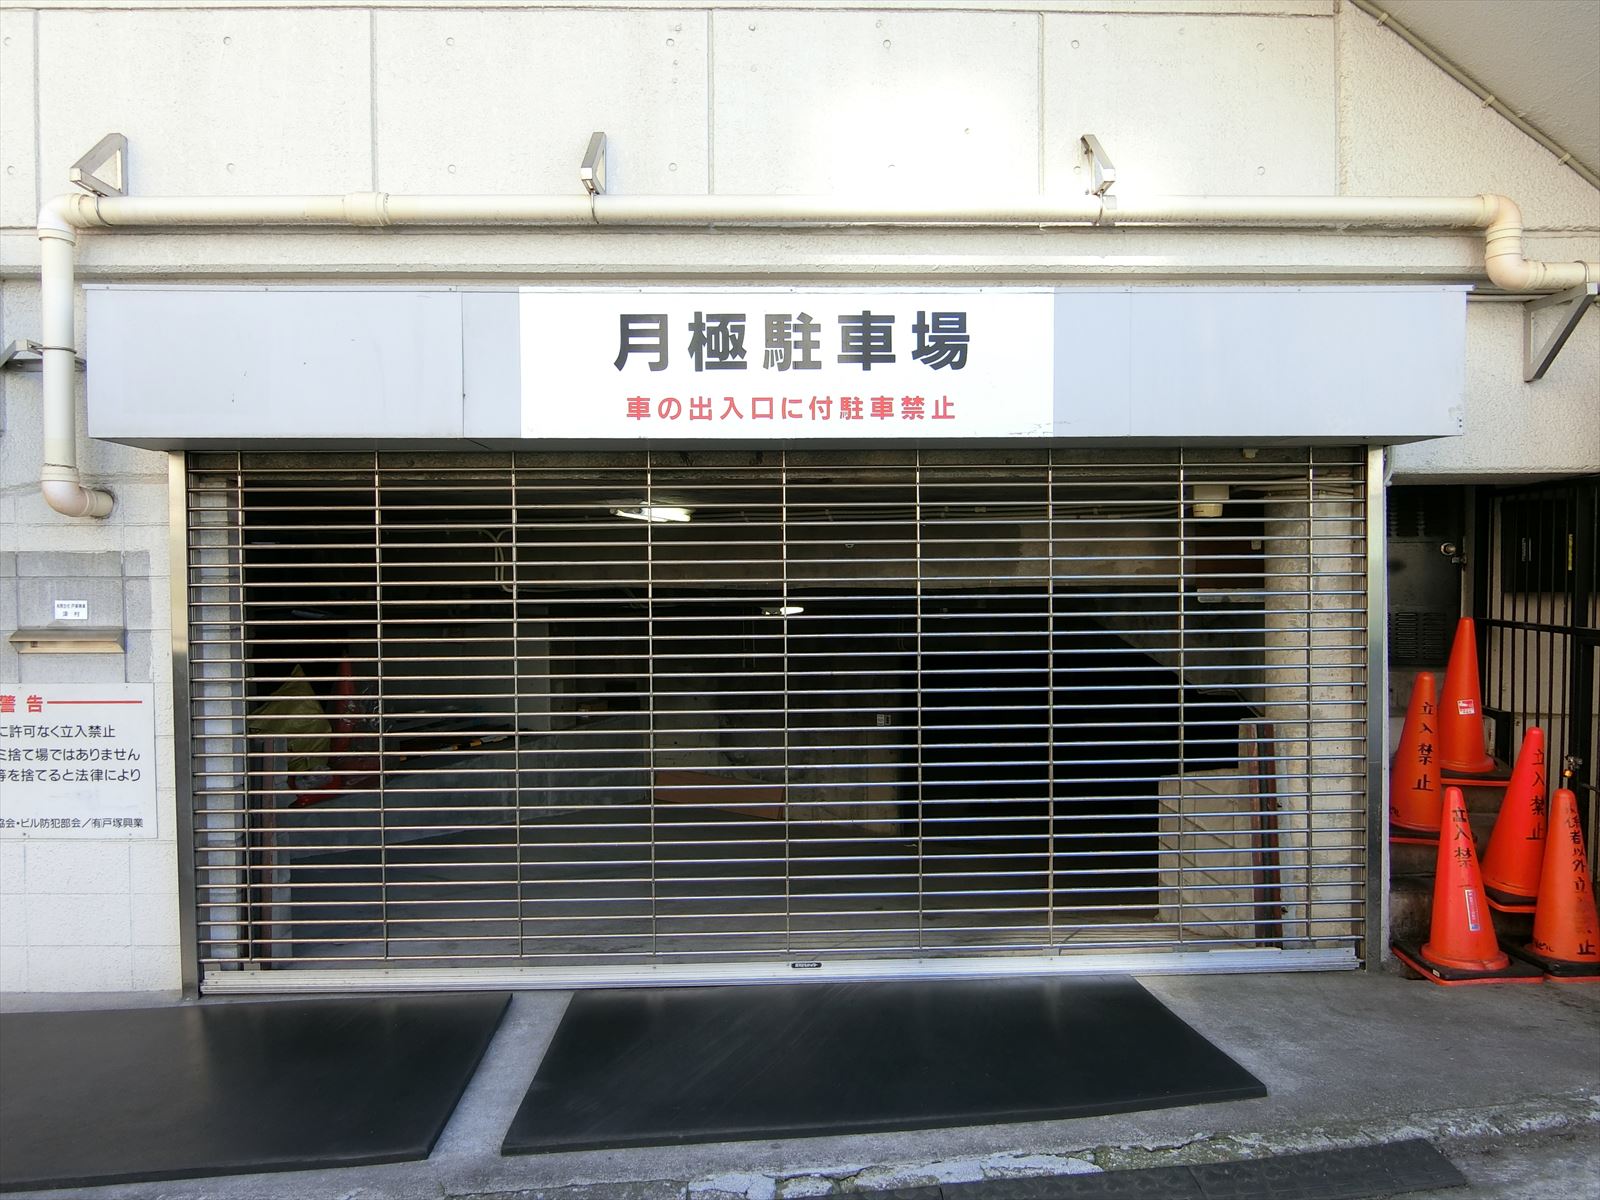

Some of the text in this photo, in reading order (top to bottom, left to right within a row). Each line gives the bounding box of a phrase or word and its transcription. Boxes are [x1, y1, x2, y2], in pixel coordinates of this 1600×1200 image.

[614, 310, 970, 372] 月極駐車場
[626, 396, 955, 421] 車の出入口に付駐車禁止
[0, 695, 43, 713] 警告
[1413, 703, 1434, 791] 立入禁止
[1525, 749, 1544, 840] 立入禁止
